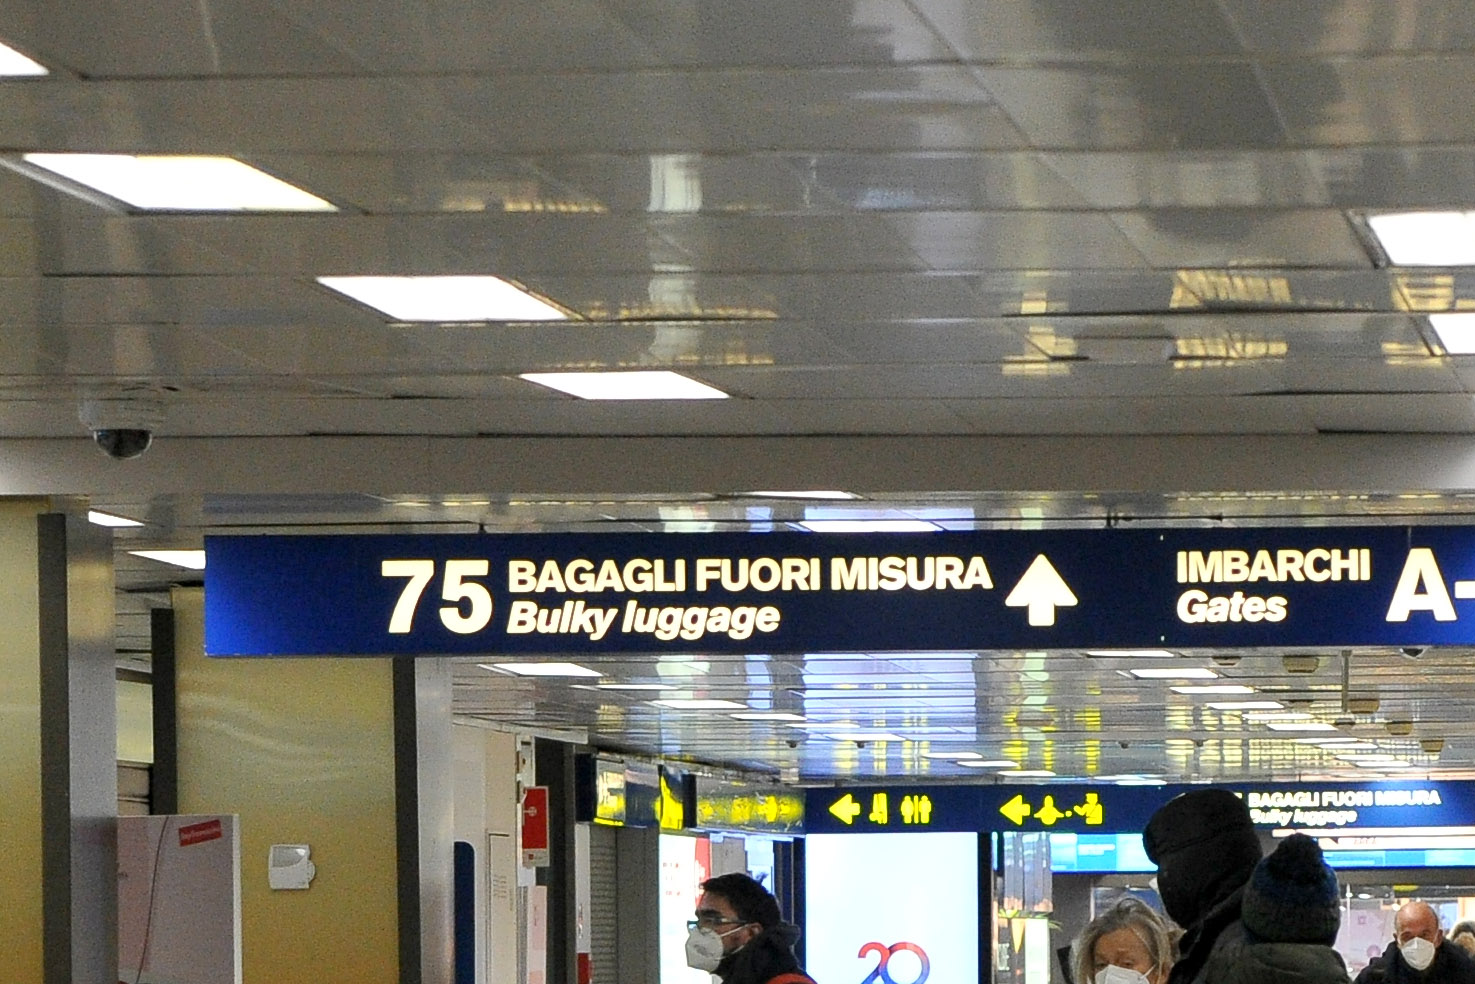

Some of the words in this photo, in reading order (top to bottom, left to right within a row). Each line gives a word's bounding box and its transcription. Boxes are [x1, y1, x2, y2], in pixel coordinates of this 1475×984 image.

[508, 558, 686, 593] BAGAGLI
[696, 557, 821, 592] FUORI
[830, 556, 994, 591] MISURA
[1176, 548, 1371, 584] IMBARCHI
[381, 559, 493, 634] 75
[1176, 589, 1288, 624] Gates
[507, 600, 616, 641] Bulky
[621, 599, 781, 641] luggage
[1321, 790, 1374, 806] FUORI
